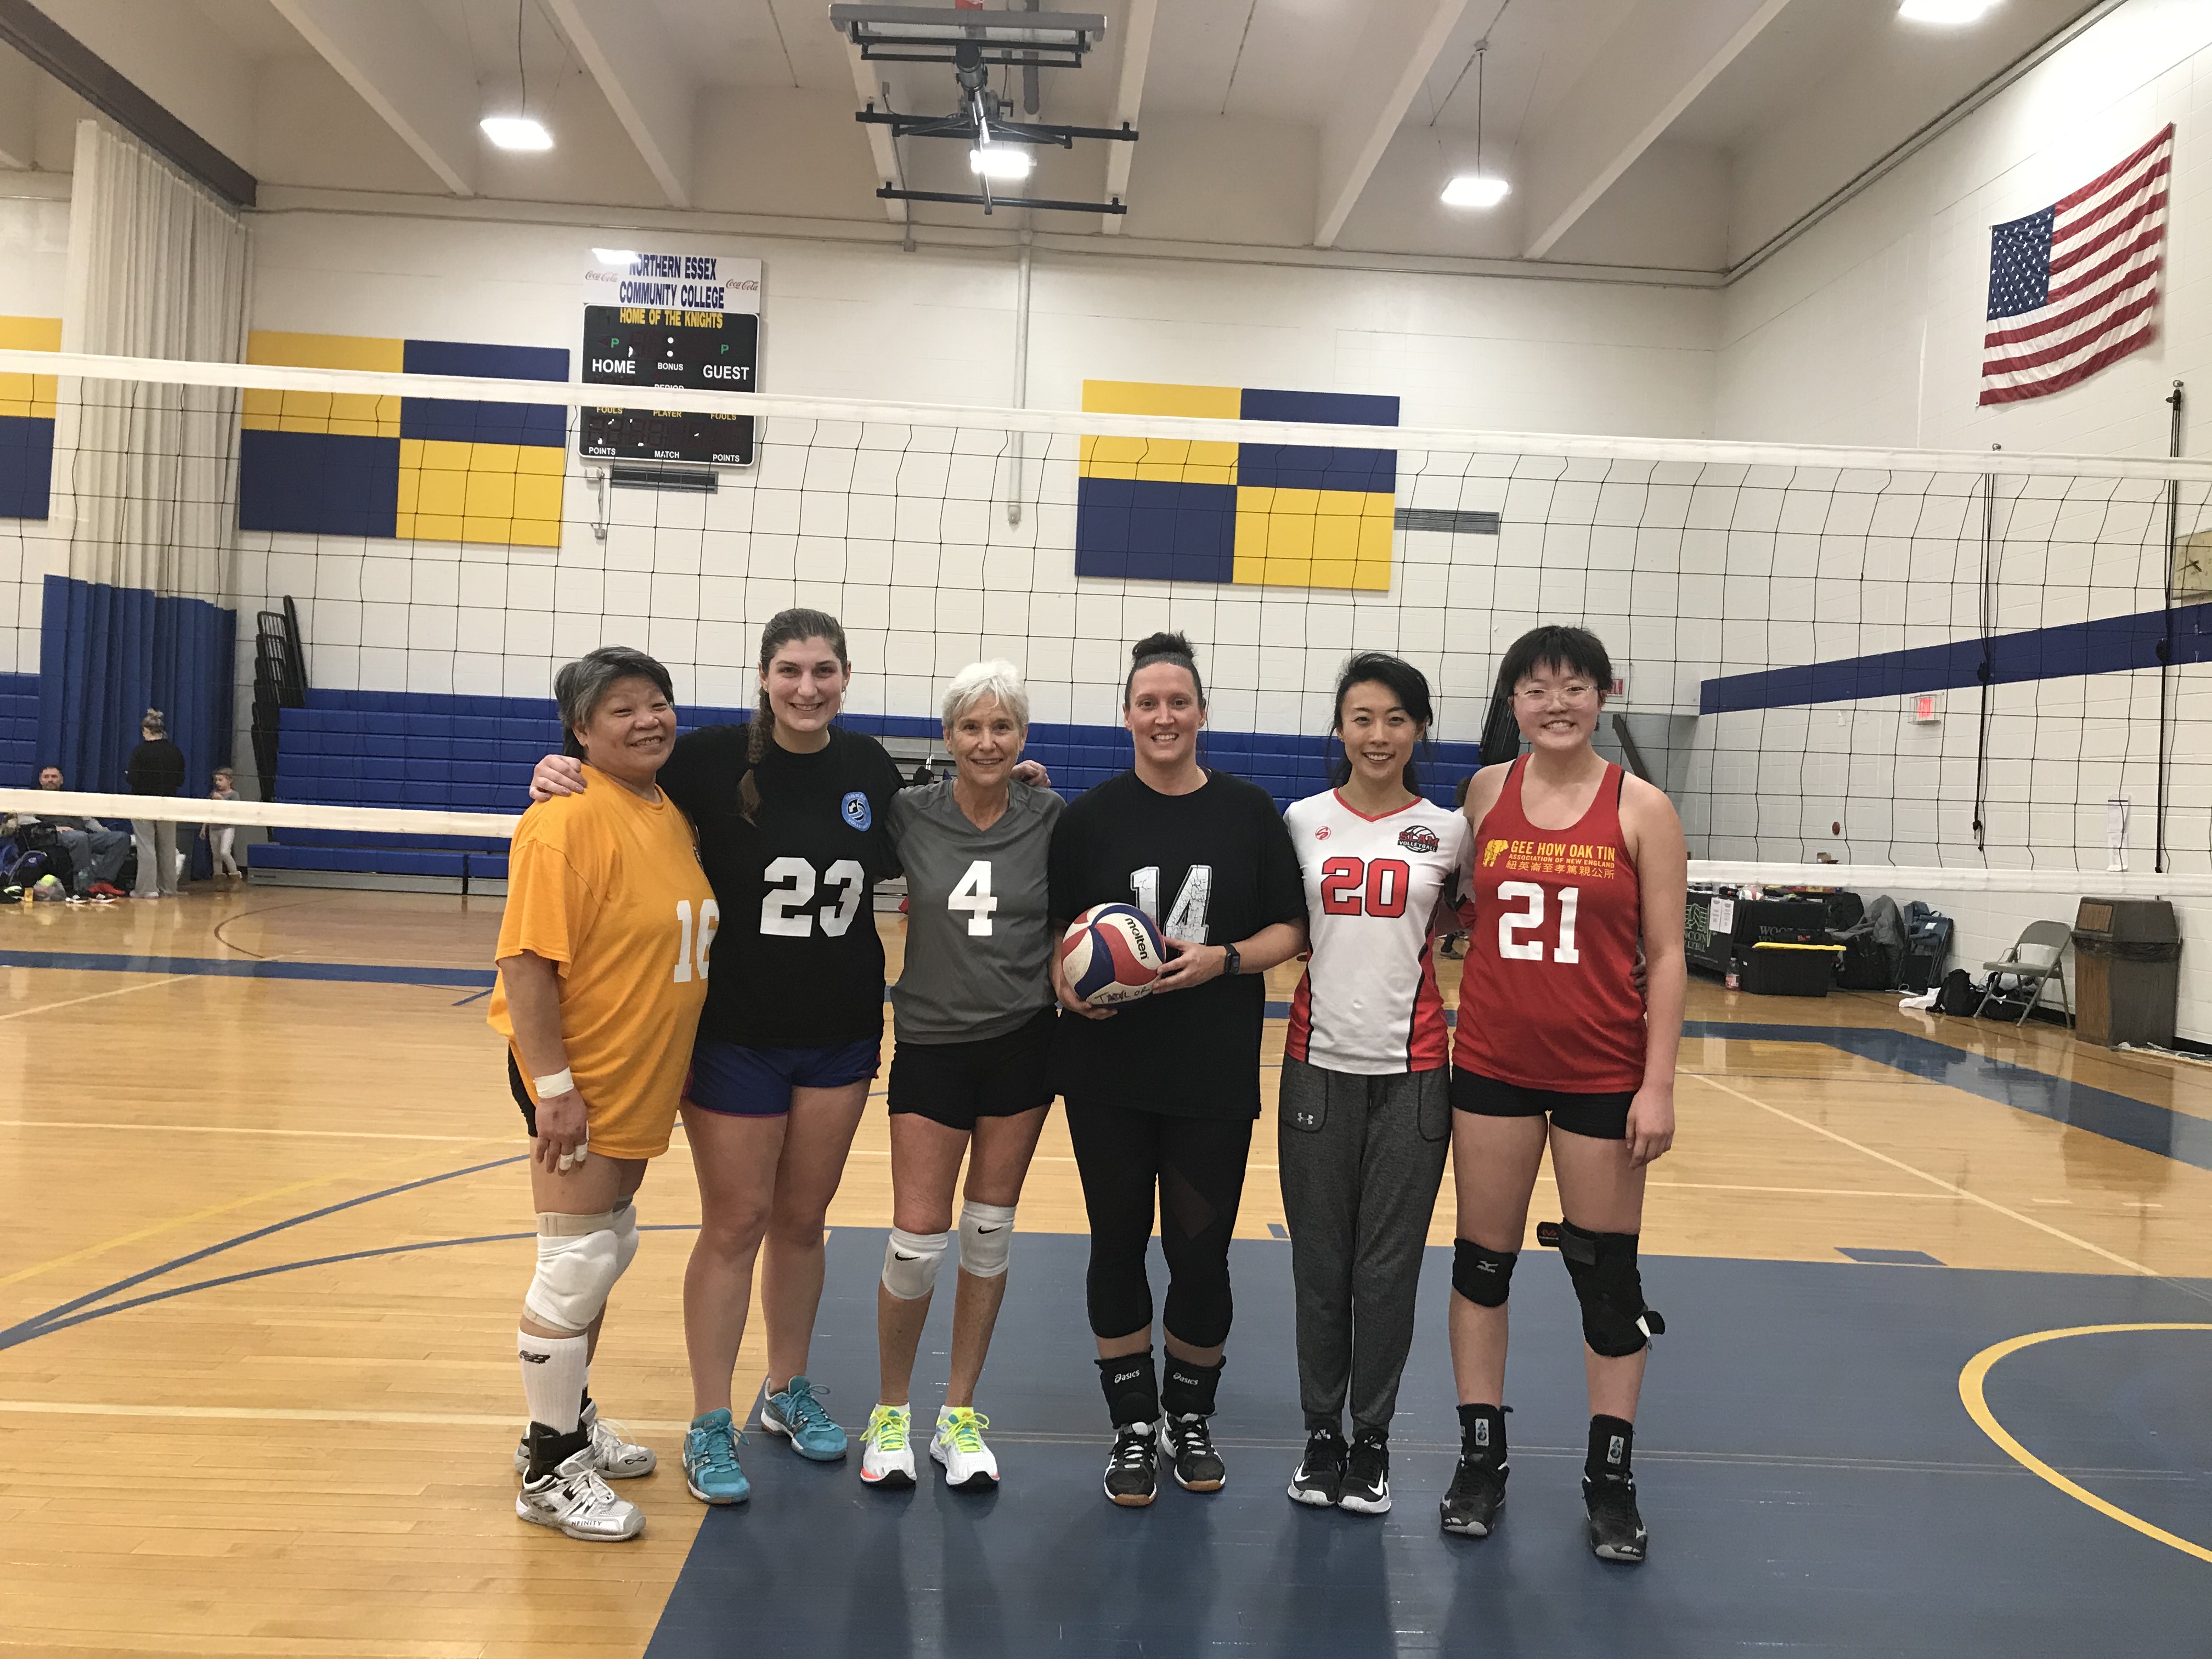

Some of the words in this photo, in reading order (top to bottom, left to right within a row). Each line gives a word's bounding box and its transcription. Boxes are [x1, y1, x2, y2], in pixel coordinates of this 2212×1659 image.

[629, 253, 681, 278] NORTHERN
[685, 256, 717, 280] ESSEX
[619, 280, 677, 306] COMMUNITY
[681, 284, 725, 308] COLLEGE
[619, 308, 646, 324] HOME
[649, 309, 661, 325] OF
[664, 309, 681, 326] THE
[685, 311, 723, 329] KNIGHTS
[611, 338, 619, 348] P
[721, 344, 729, 354] P
[592, 359, 636, 374] HOME
[657, 362, 684, 371] BONUS
[703, 365, 749, 380] GUEST
[589, 447, 616, 455] POINTS
[654, 450, 680, 459] MATCH
[713, 454, 740, 462] POINTS
[1398, 831, 1440, 847] SLAM
[1399, 840, 1436, 851] VOLLEYBALL
[1510, 840, 1534, 854] GEE
[1537, 842, 1566, 856] HOW
[1569, 844, 1593, 859] OAK
[1597, 845, 1615, 861] TIN
[1509, 854, 1553, 863] ASSOCIATION
[1584, 860, 1615, 868] ENGLAND
[1321, 856, 1410, 918] 20
[760, 857, 865, 937] 23
[947, 860, 998, 936] 4
[1130, 865, 1212, 945] 14
[1497, 881, 1579, 964] 21
[674, 899, 720, 983] 16
[1125, 918, 1148, 960] molten
[1114, 1369, 1140, 1384] asics
[1173, 1372, 1199, 1385] asics
